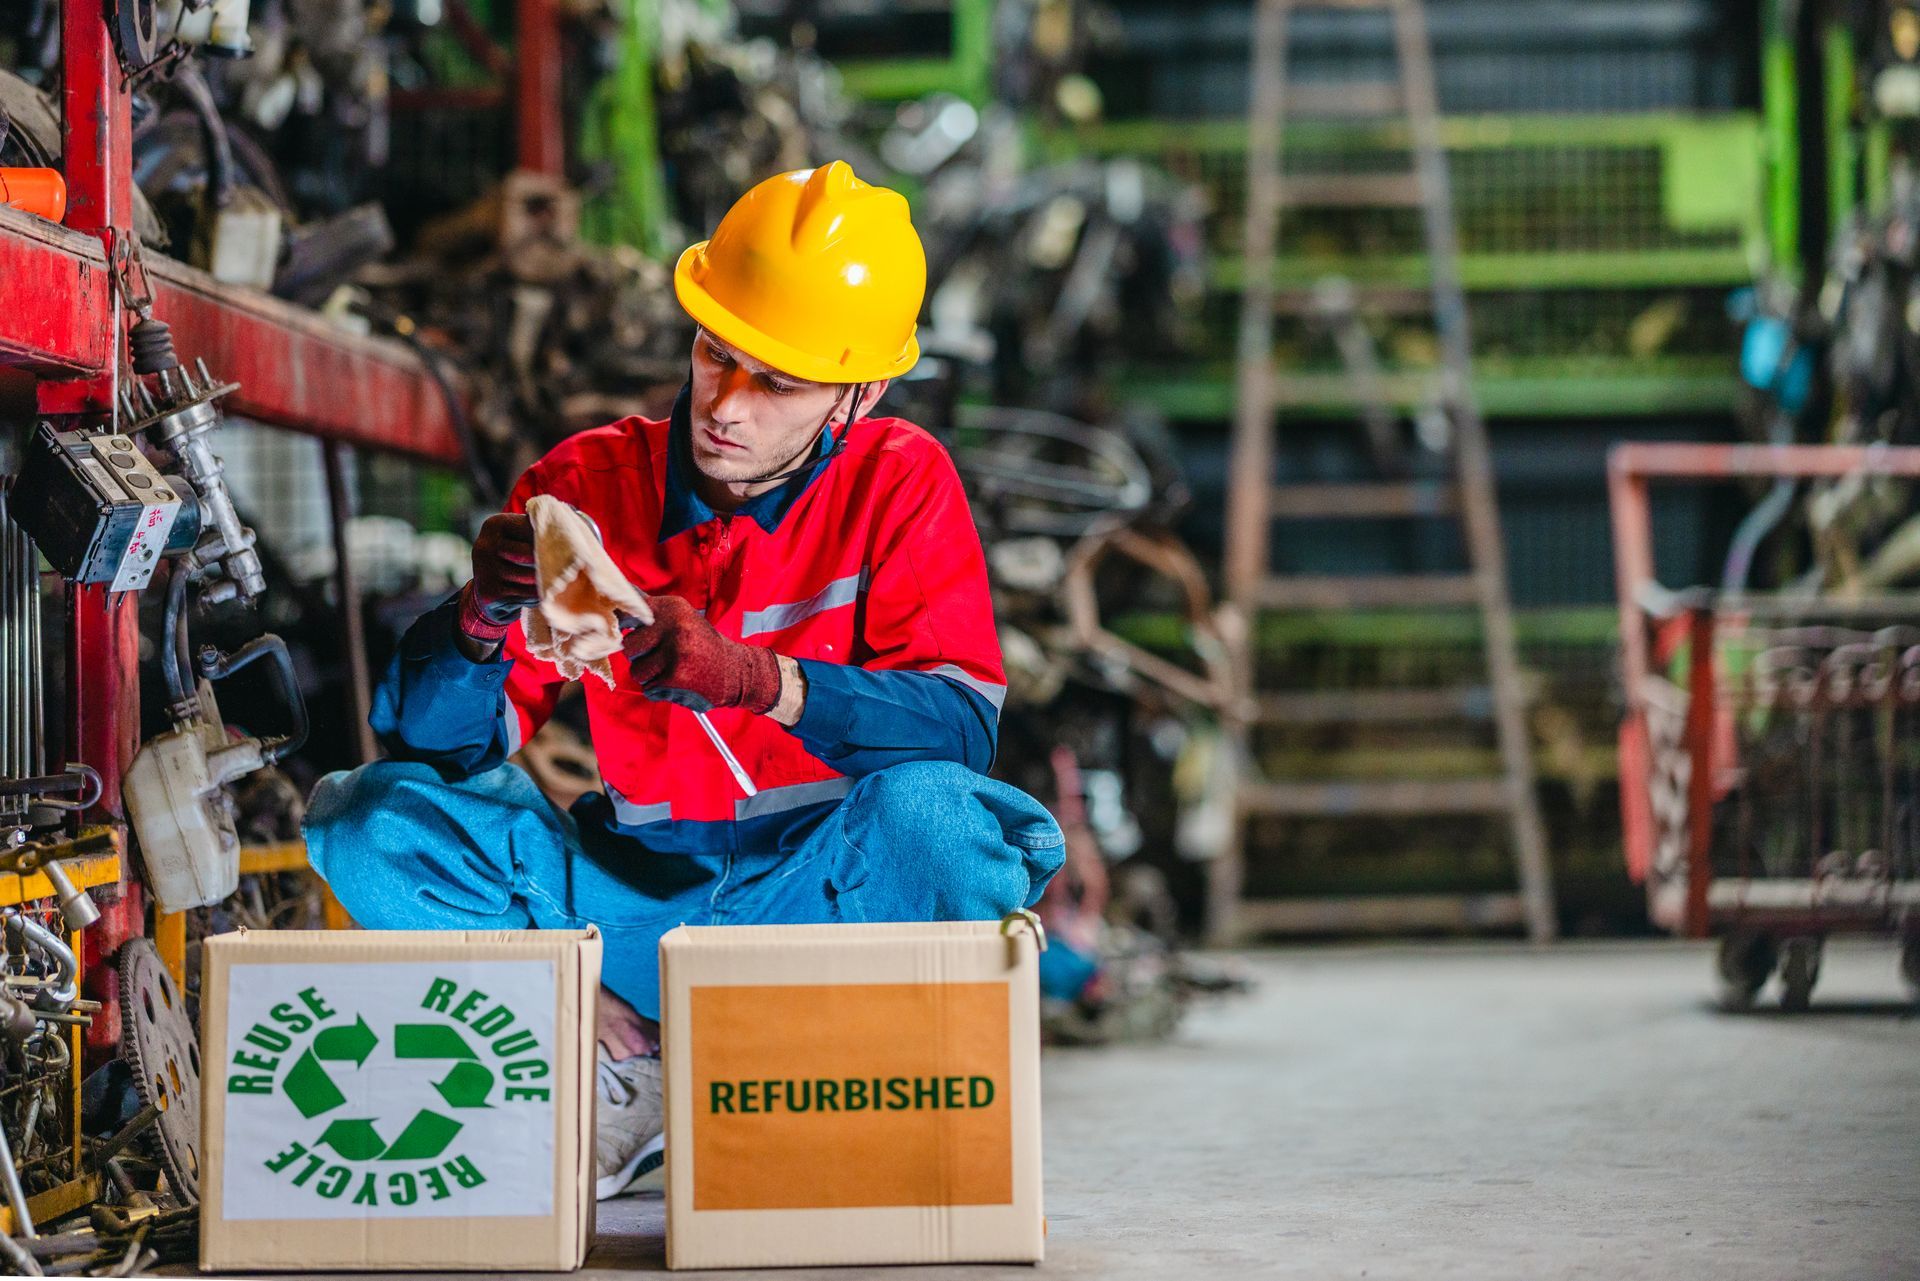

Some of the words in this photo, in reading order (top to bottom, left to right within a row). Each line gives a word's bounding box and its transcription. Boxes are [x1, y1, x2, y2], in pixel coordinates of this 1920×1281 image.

[227, 987, 336, 1095] REUSE
[421, 976, 551, 1102] REDUCE
[709, 1076, 995, 1114] REFURBISHED
[264, 1141, 487, 1207] RECYCLE
